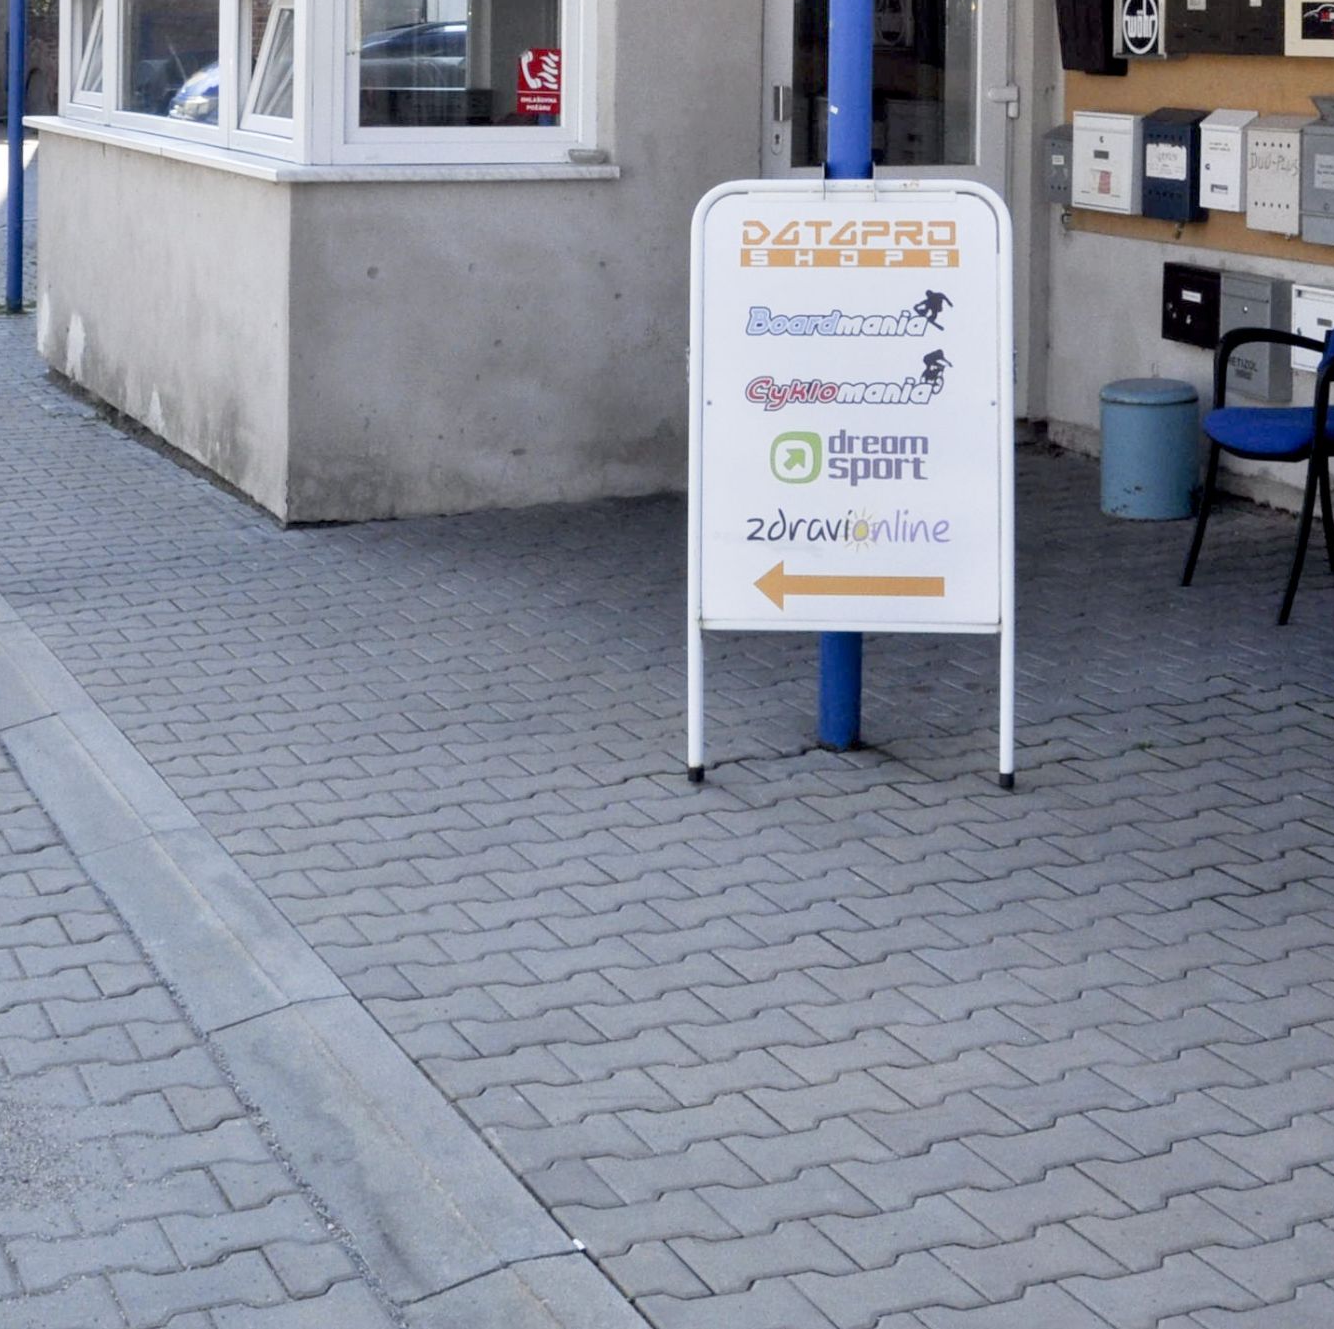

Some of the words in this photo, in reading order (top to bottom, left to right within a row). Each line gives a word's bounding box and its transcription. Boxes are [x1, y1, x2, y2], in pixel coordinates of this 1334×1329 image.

[742, 220, 956, 246] DATAPRO
[748, 249, 949, 266] SHOPS
[746, 306, 930, 337] Boardmania
[745, 376, 935, 411] Cyklomania
[828, 429, 929, 455] dream
[828, 456, 929, 487] sport
